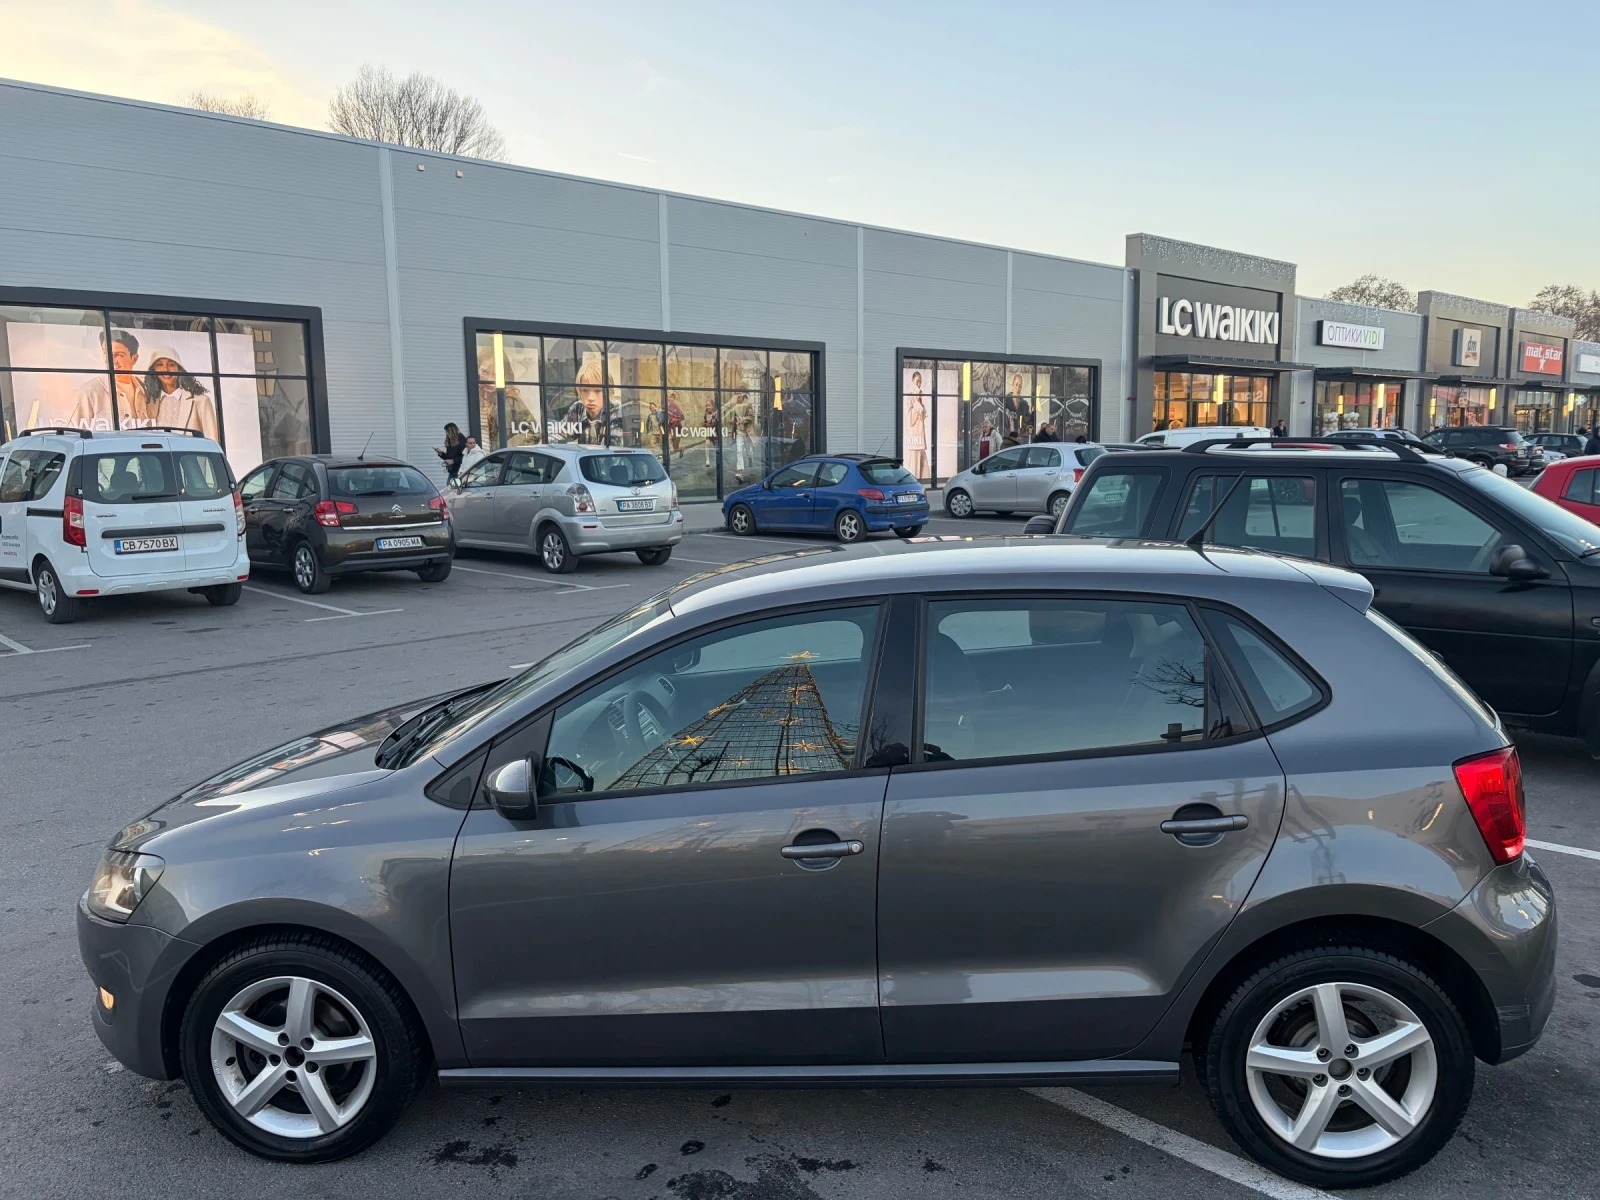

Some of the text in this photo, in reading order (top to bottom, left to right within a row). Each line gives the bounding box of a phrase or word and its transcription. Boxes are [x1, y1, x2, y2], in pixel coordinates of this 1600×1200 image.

[1160, 297, 1193, 336] LC
[1327, 325, 1381, 345] ОПТИКИ VIDI
[1525, 345, 1563, 361] mat star
[511, 421, 530, 434] LC
[675, 426, 689, 438] LC
[122, 538, 175, 551] CB 7570 BX
[383, 538, 421, 548] PA 0905 MA
